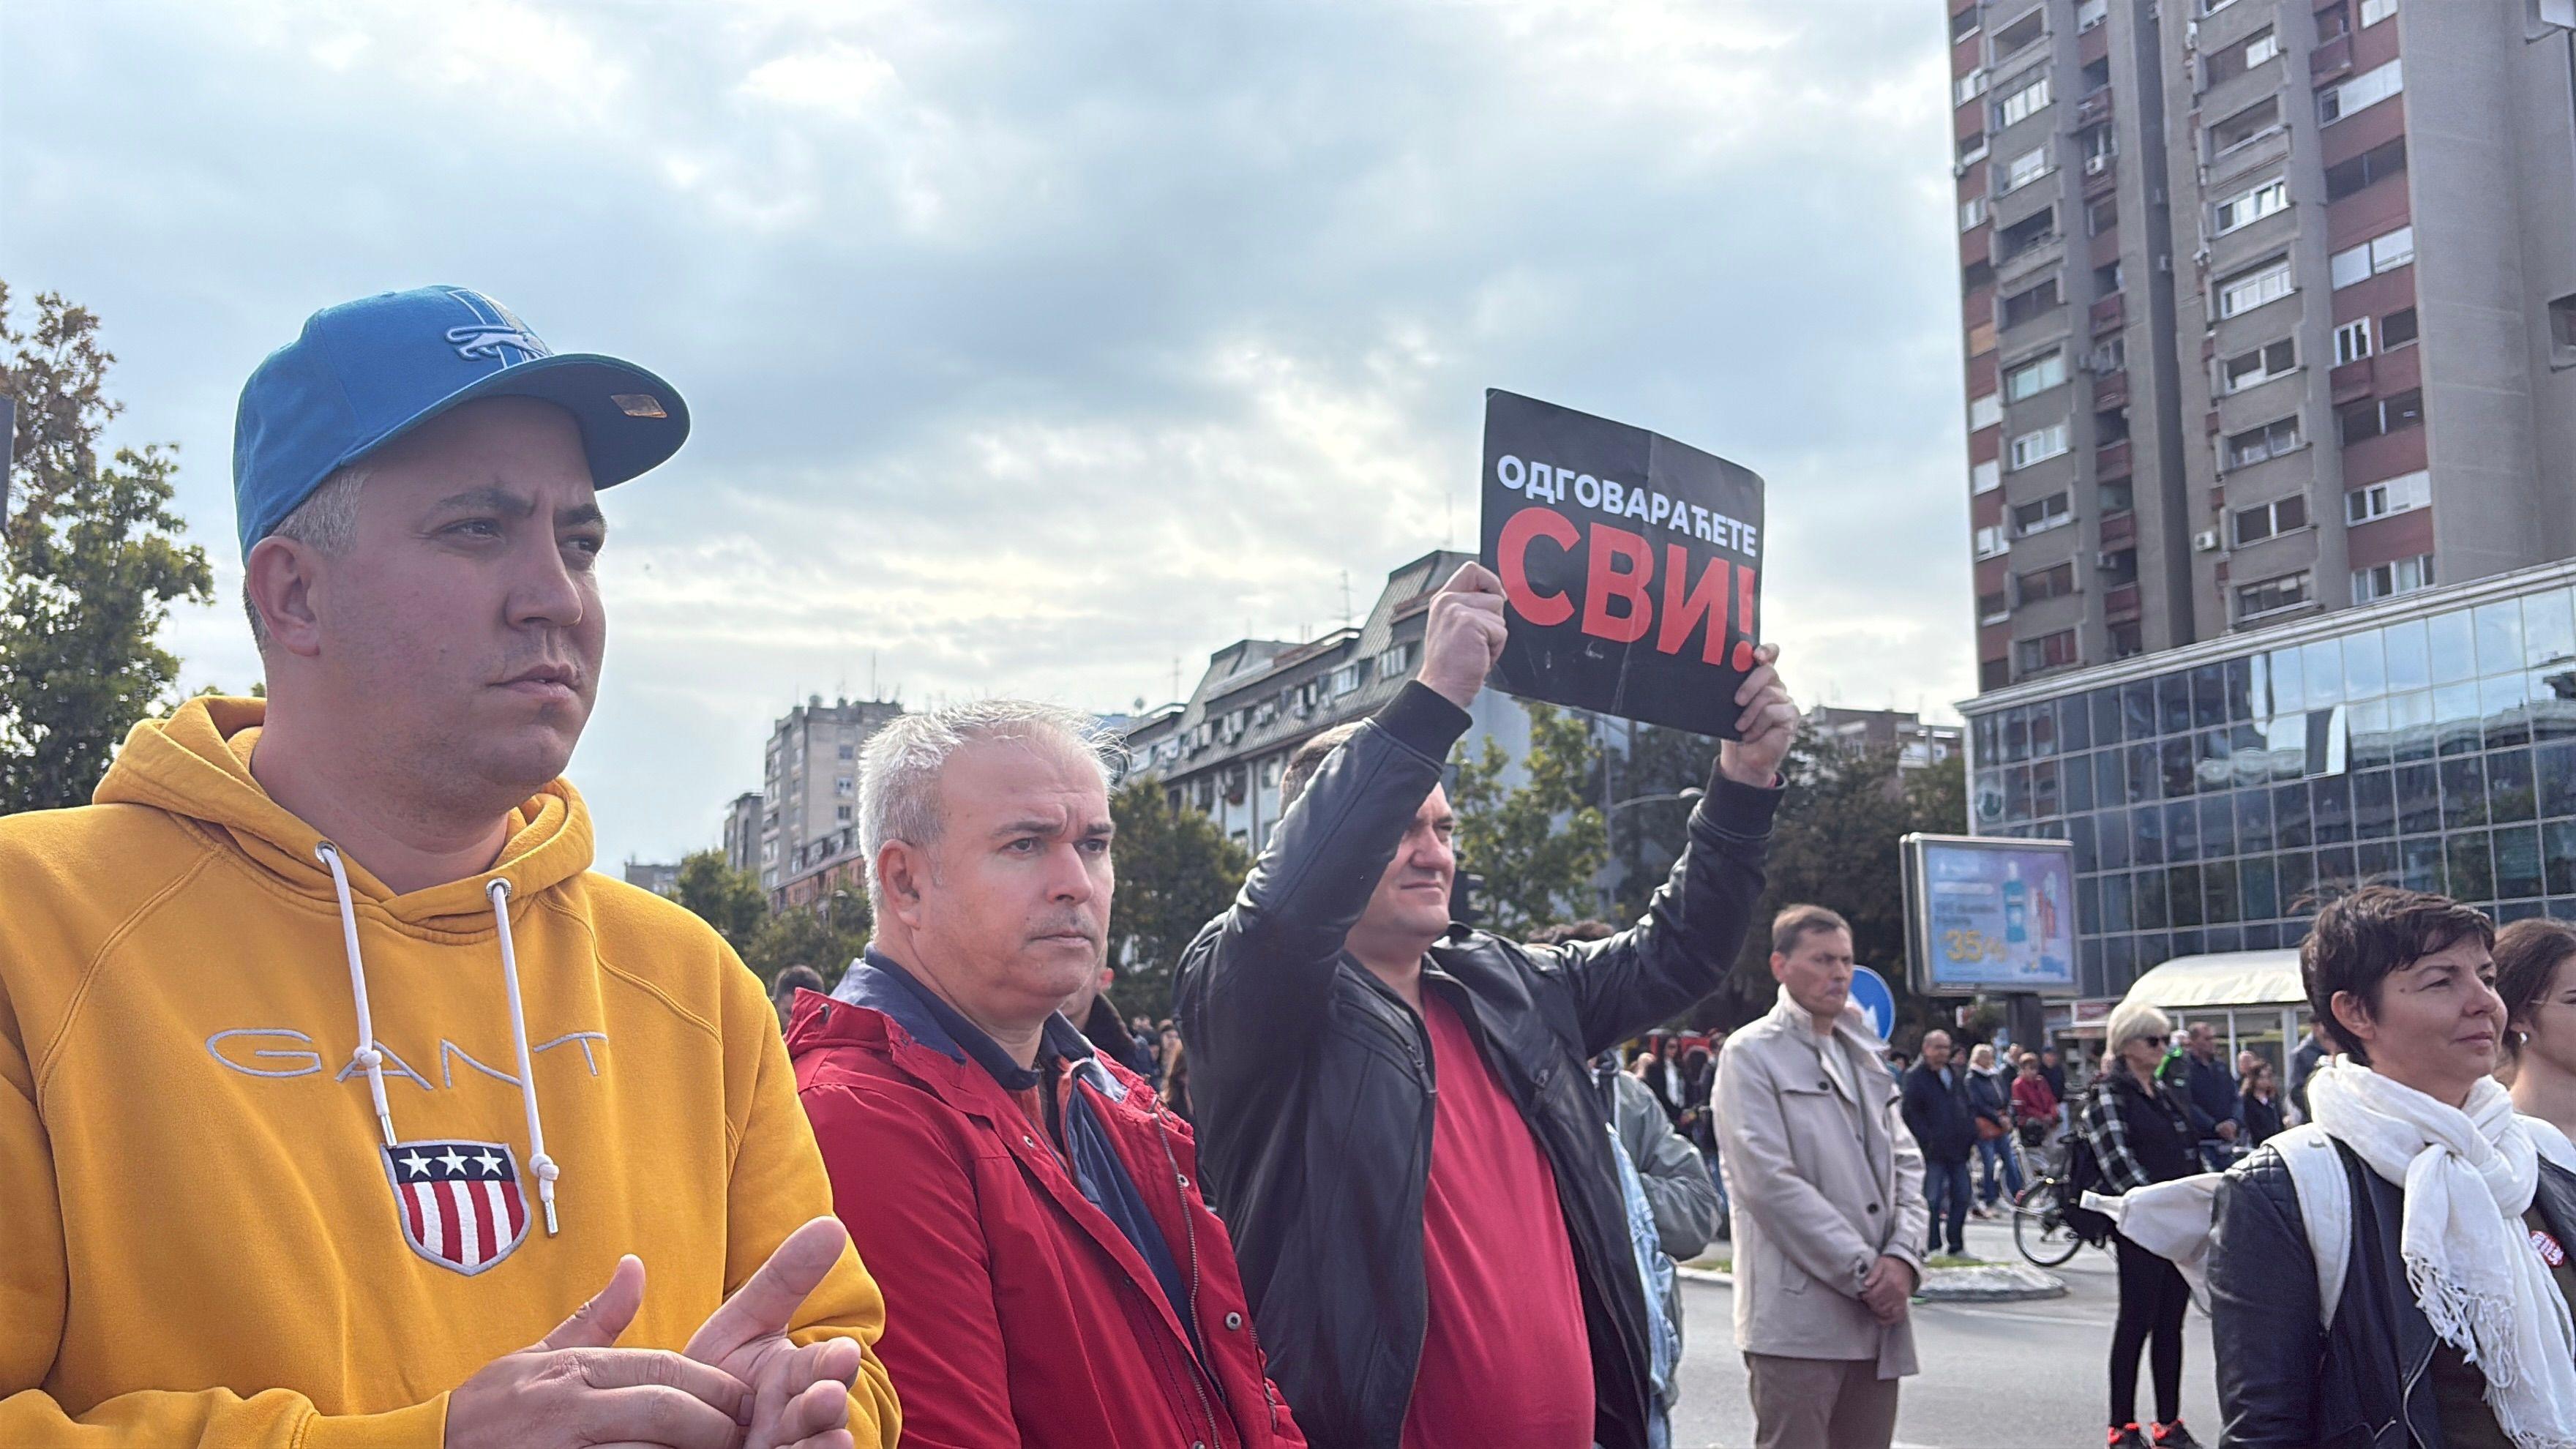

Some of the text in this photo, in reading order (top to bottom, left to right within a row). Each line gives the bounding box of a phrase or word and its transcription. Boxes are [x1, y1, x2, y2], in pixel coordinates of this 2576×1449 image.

[1497, 454, 1757, 557] ОДГОВАРАЋЕТЕ
[1497, 506, 1757, 673] СВИ!
[205, 1027, 608, 1090] GANT
